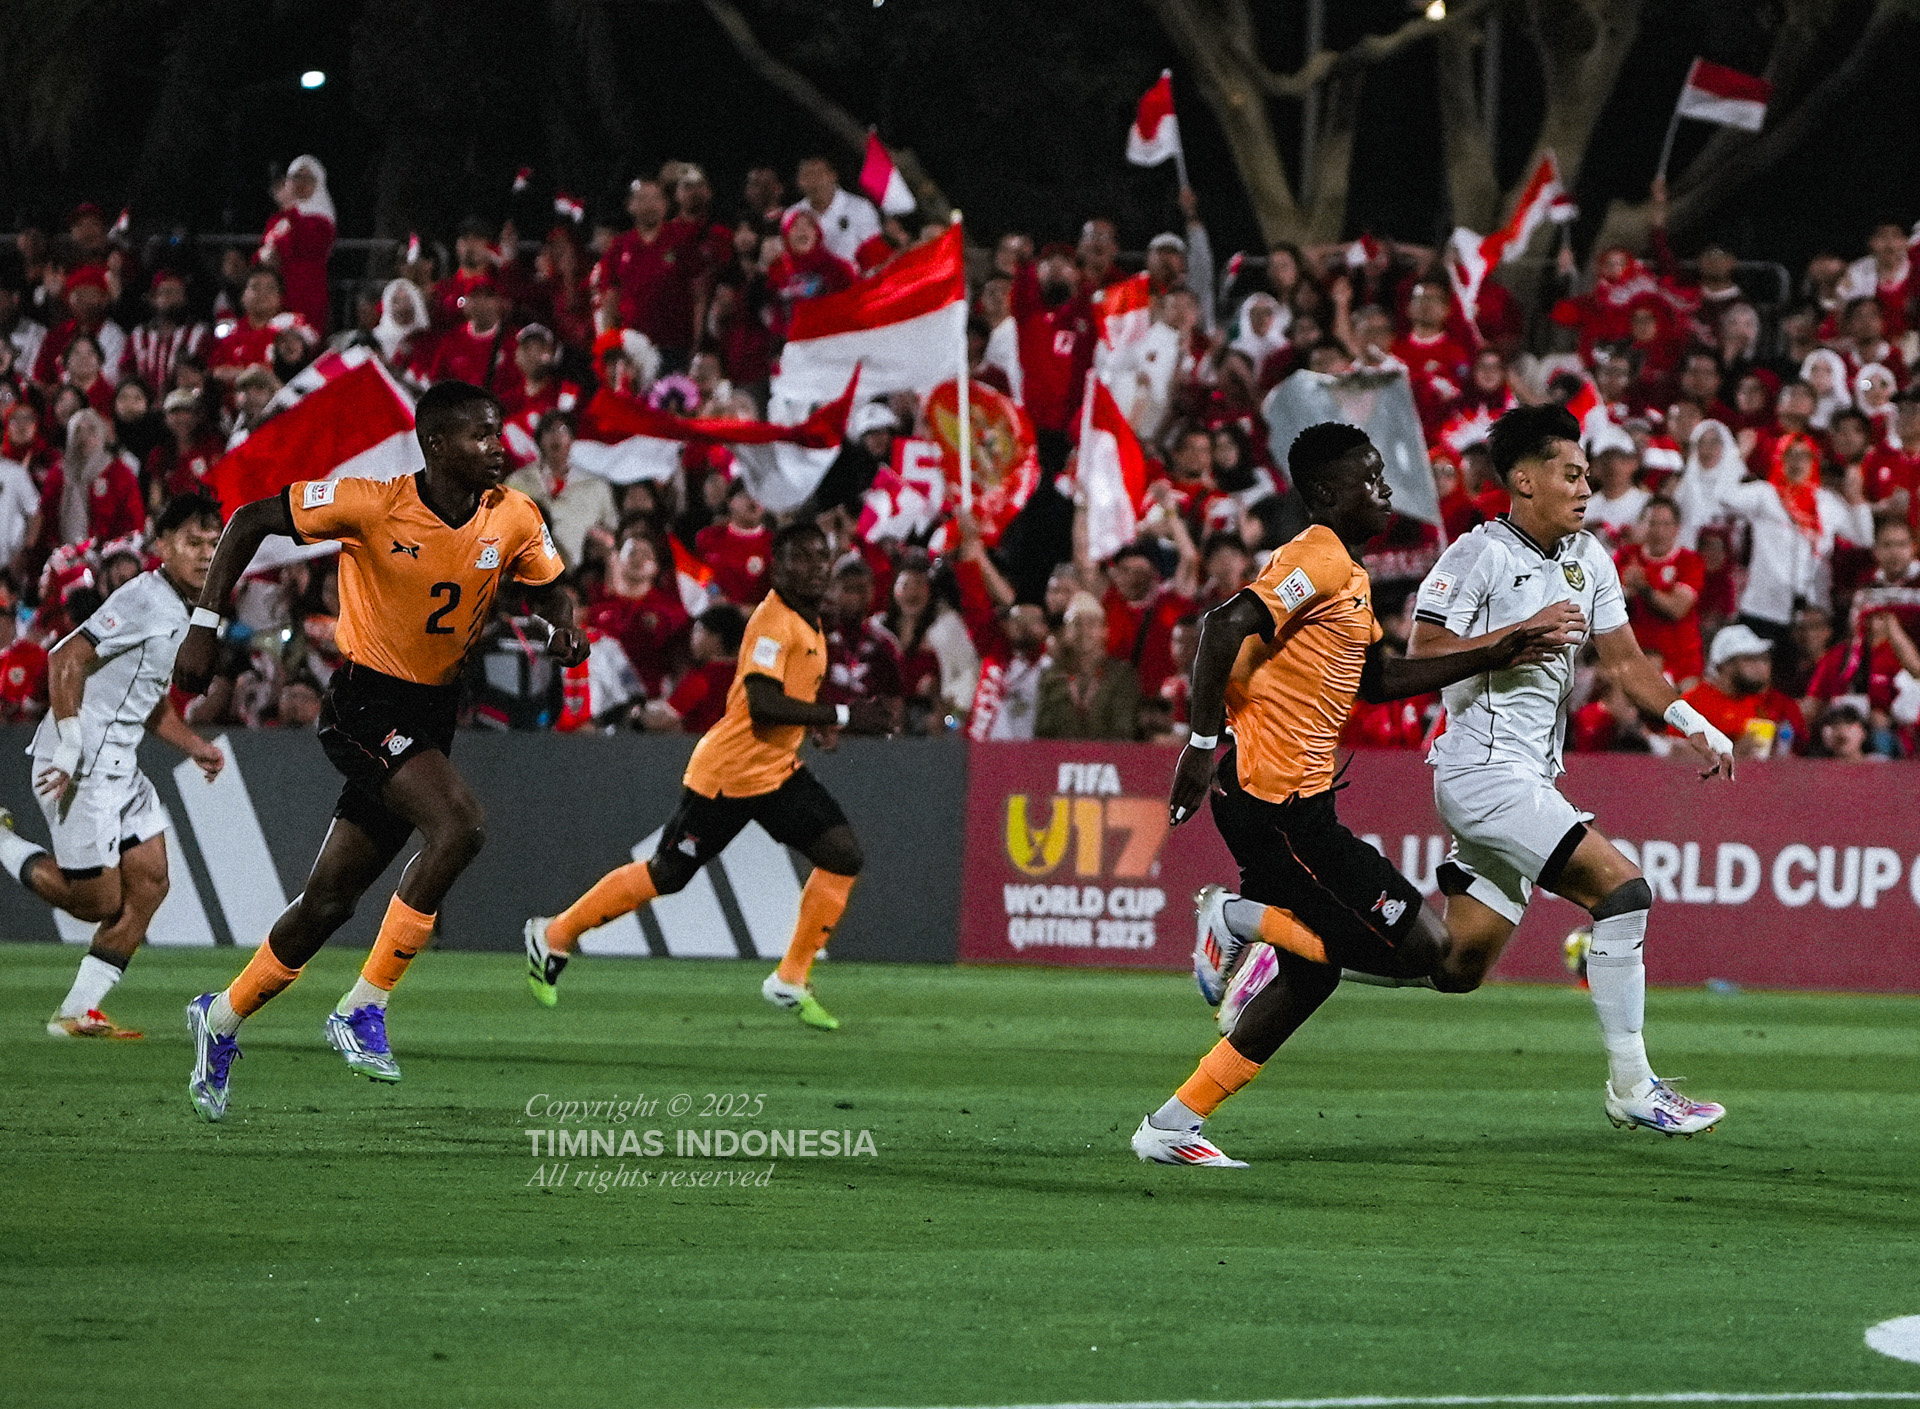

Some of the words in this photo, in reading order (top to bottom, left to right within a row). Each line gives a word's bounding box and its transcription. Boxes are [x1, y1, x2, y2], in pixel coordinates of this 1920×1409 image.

[425, 582, 461, 634] 2
[1058, 763, 1121, 795] FIFA
[1007, 796, 1170, 877] U17
[1004, 884, 1105, 917] WORLD
[1107, 887, 1166, 919] CUP
[1772, 843, 1902, 909] CUP
